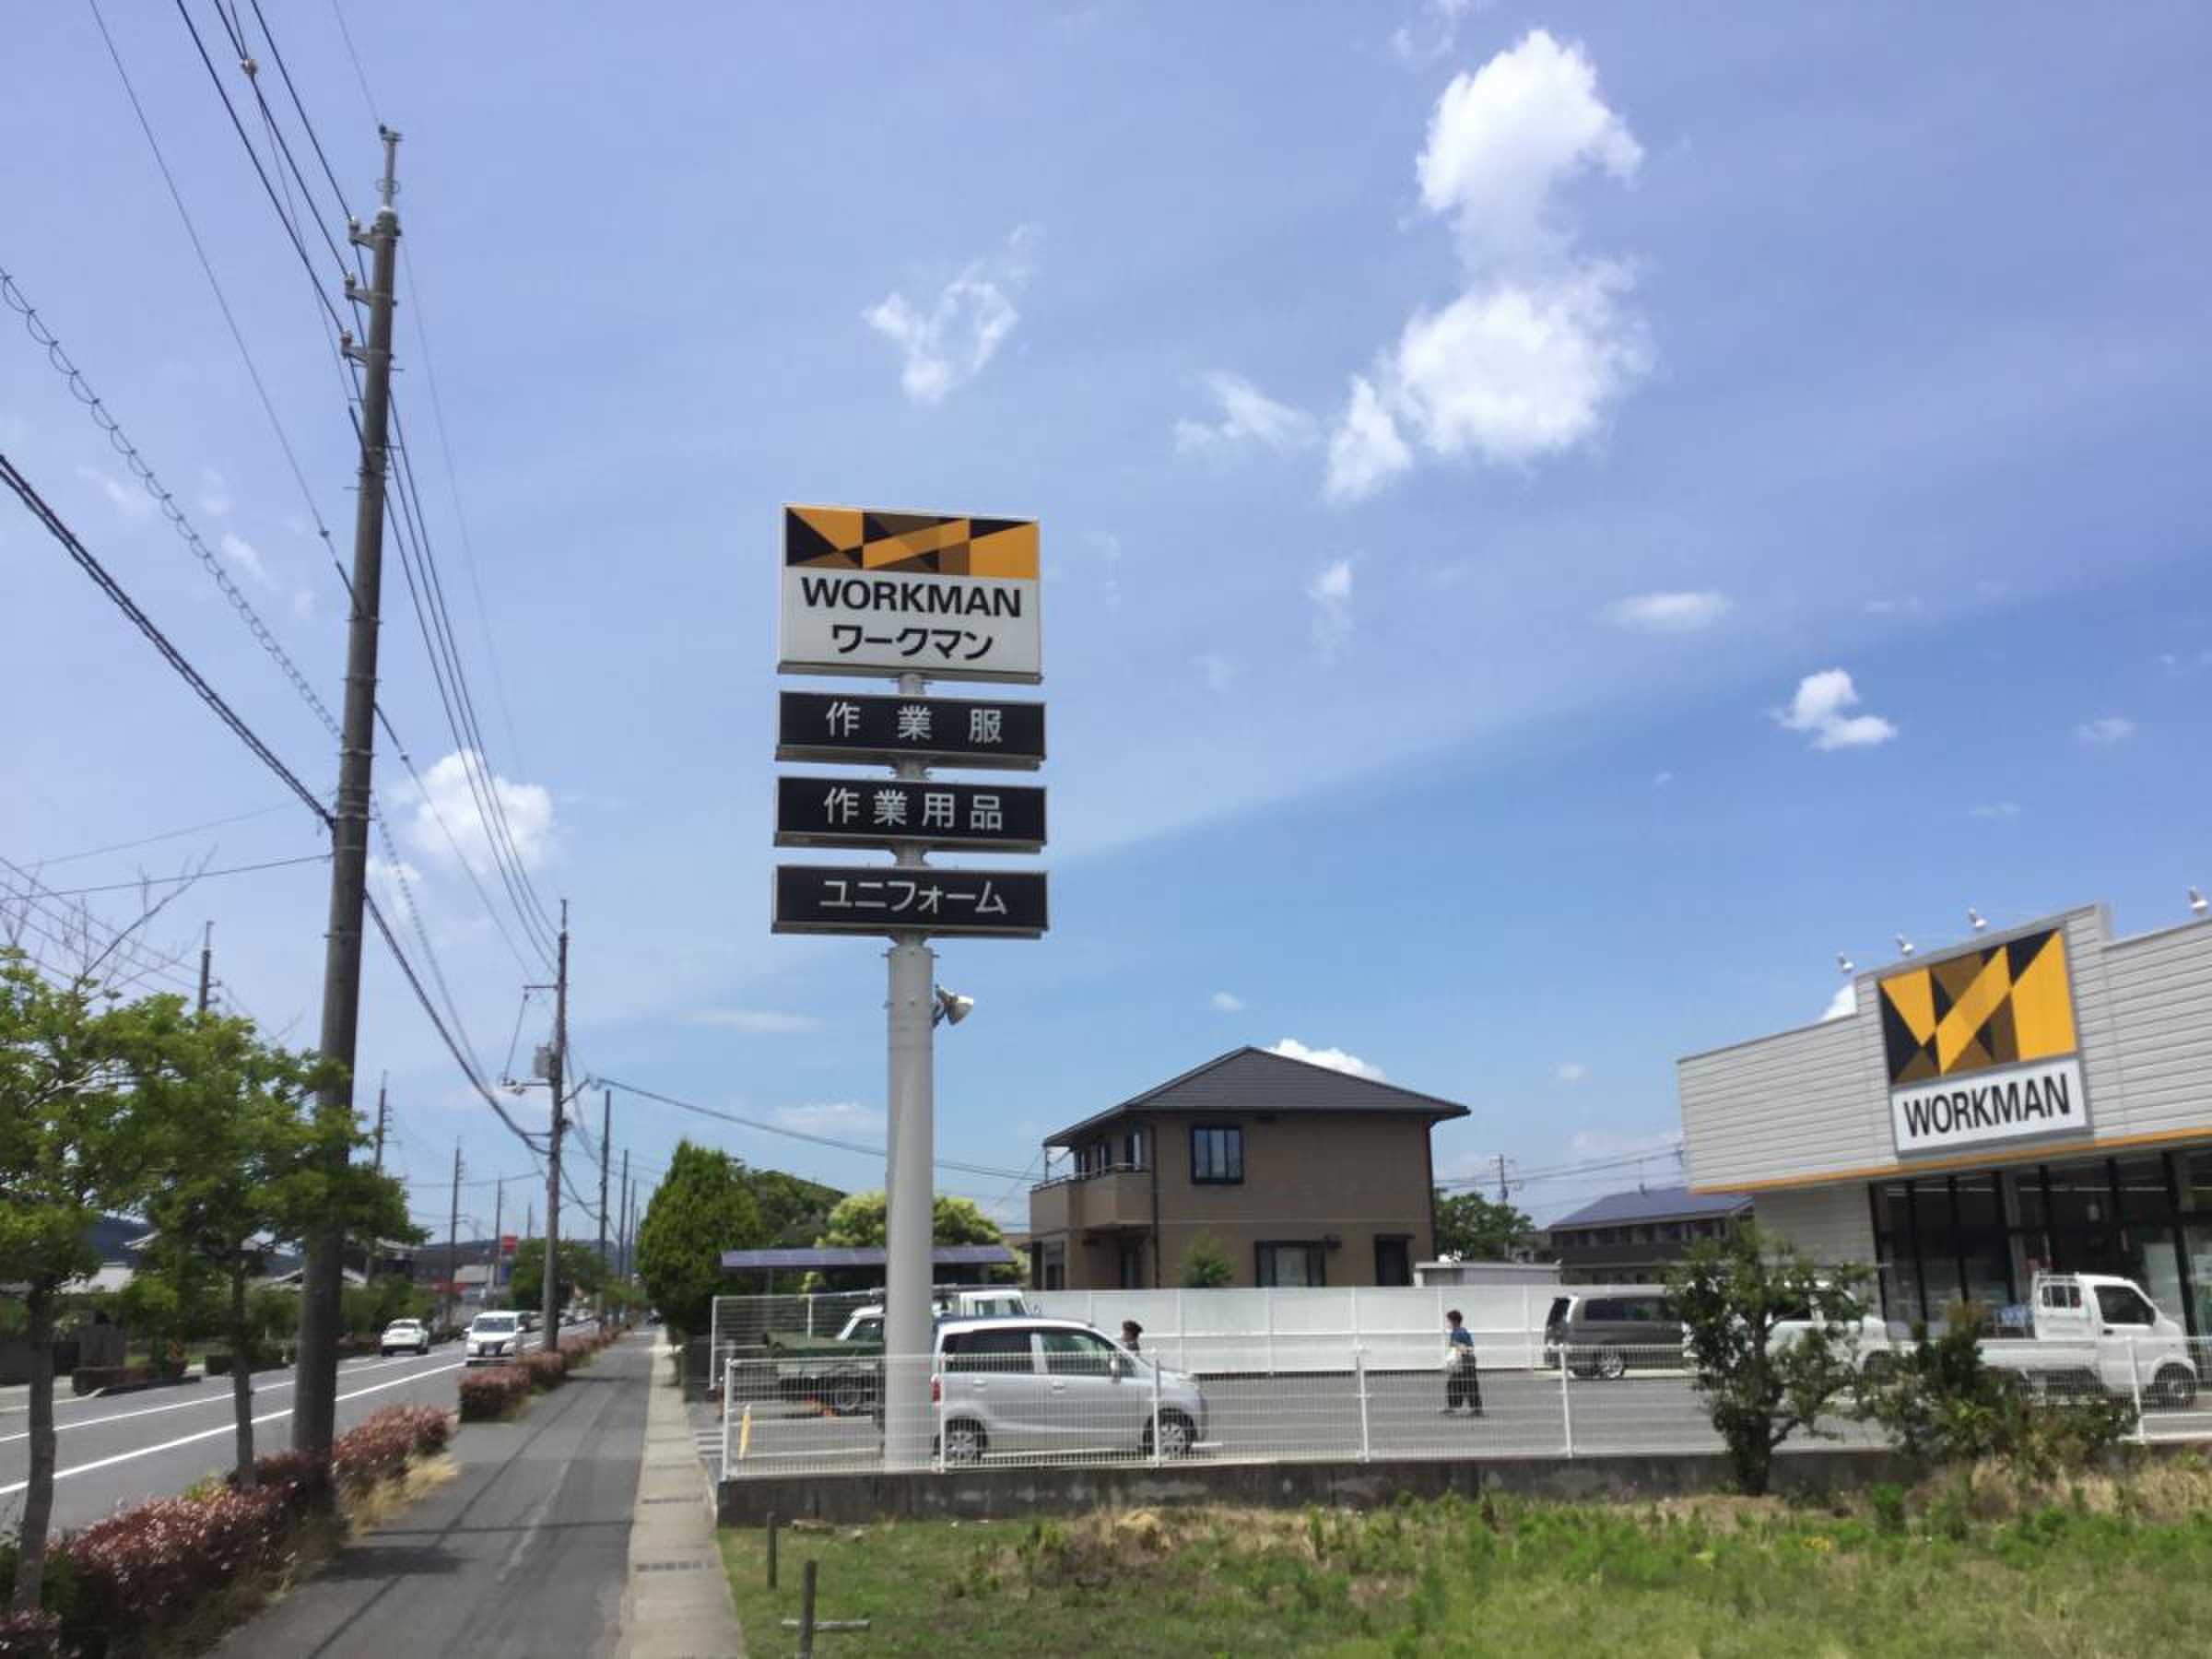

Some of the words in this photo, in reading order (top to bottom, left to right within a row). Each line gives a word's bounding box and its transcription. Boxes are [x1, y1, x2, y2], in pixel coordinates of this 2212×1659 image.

[801, 576, 1022, 618] WORKMAN
[831, 624, 994, 660] ワークマン
[826, 701, 1003, 744] 作業服
[823, 787, 1004, 830] 作業用品
[819, 880, 1007, 914] ユニフォーム
[1903, 1074, 2070, 1137] WORKMAN
